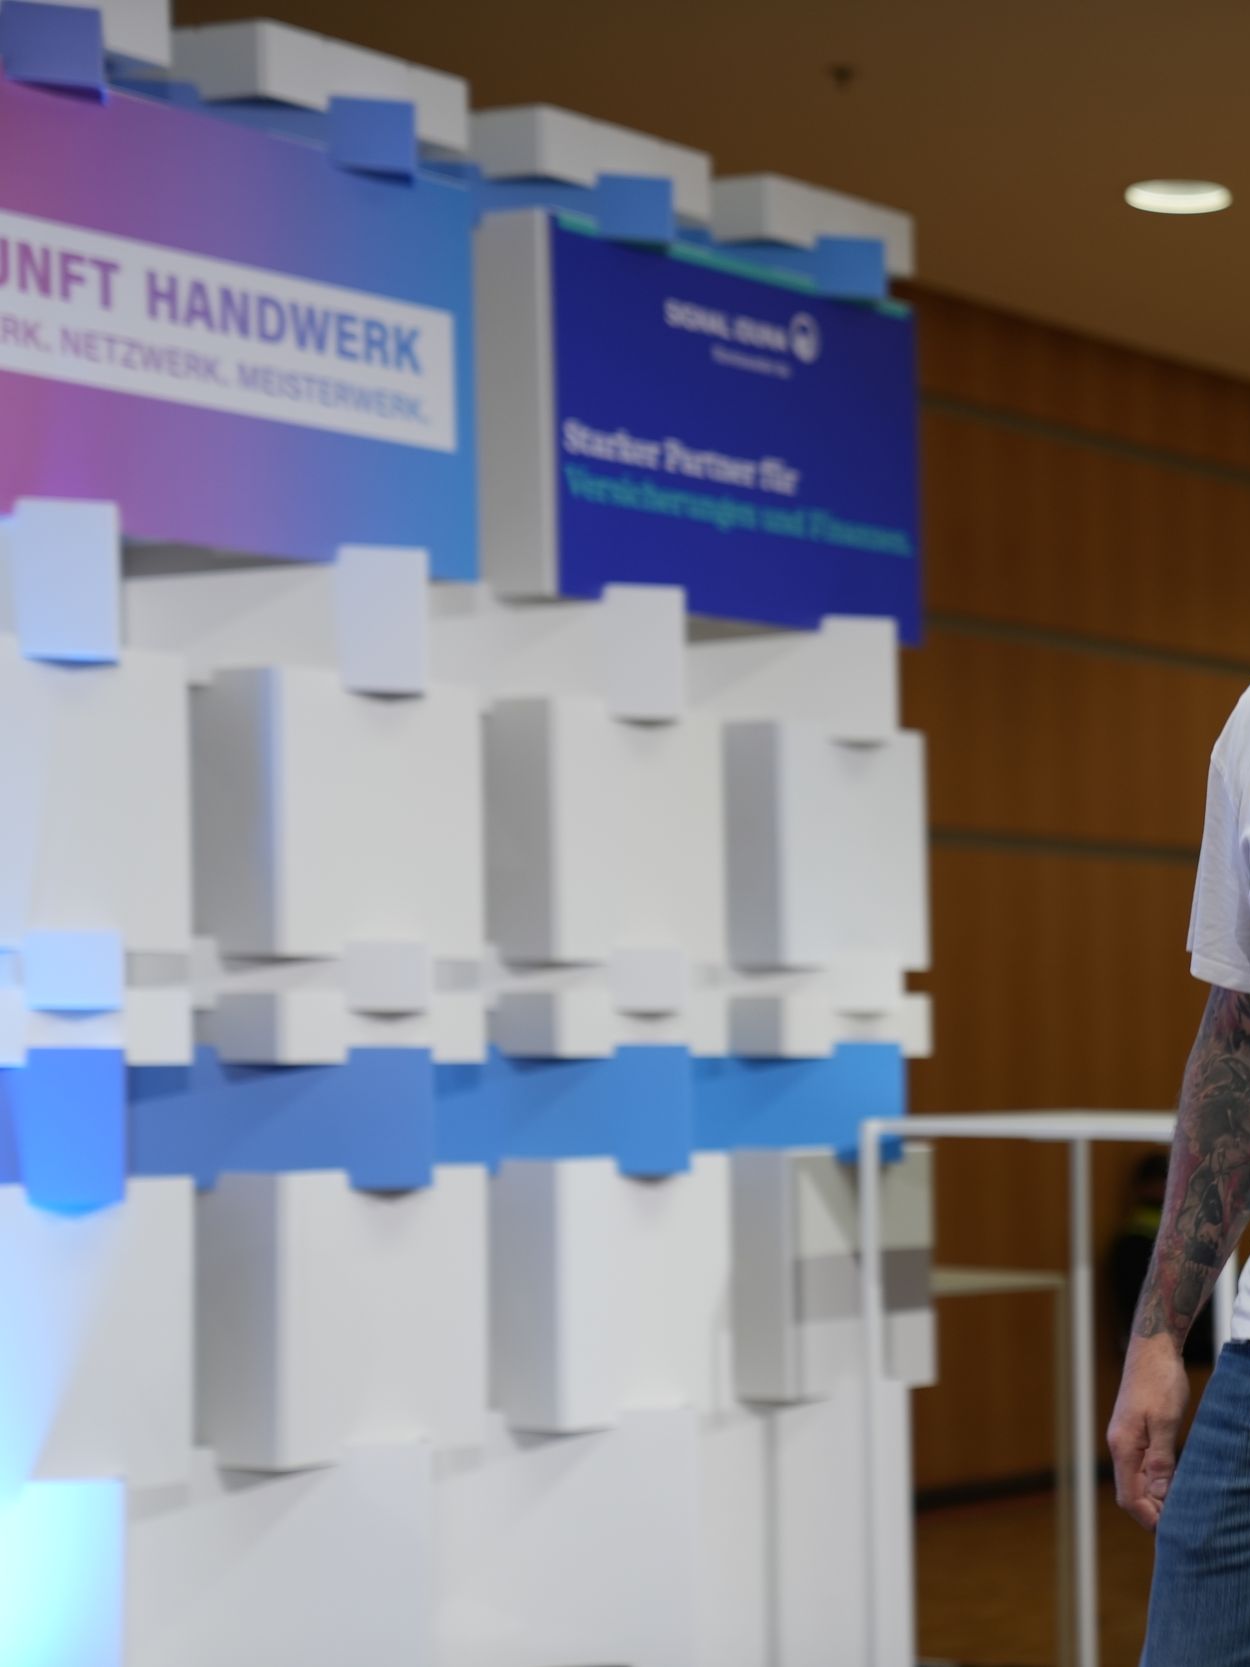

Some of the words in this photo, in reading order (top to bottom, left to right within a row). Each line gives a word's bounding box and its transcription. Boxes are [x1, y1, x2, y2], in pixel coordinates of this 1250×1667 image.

[145, 267, 424, 376] HANDWERK
[60, 326, 228, 388] NETZWERK.
[236, 361, 432, 425] MEISTERWERK.
[562, 417, 660, 471] Starker
[663, 437, 756, 490] Partner
[758, 456, 800, 497] für
[563, 462, 757, 533] Versicherungen
[760, 504, 807, 539] und
